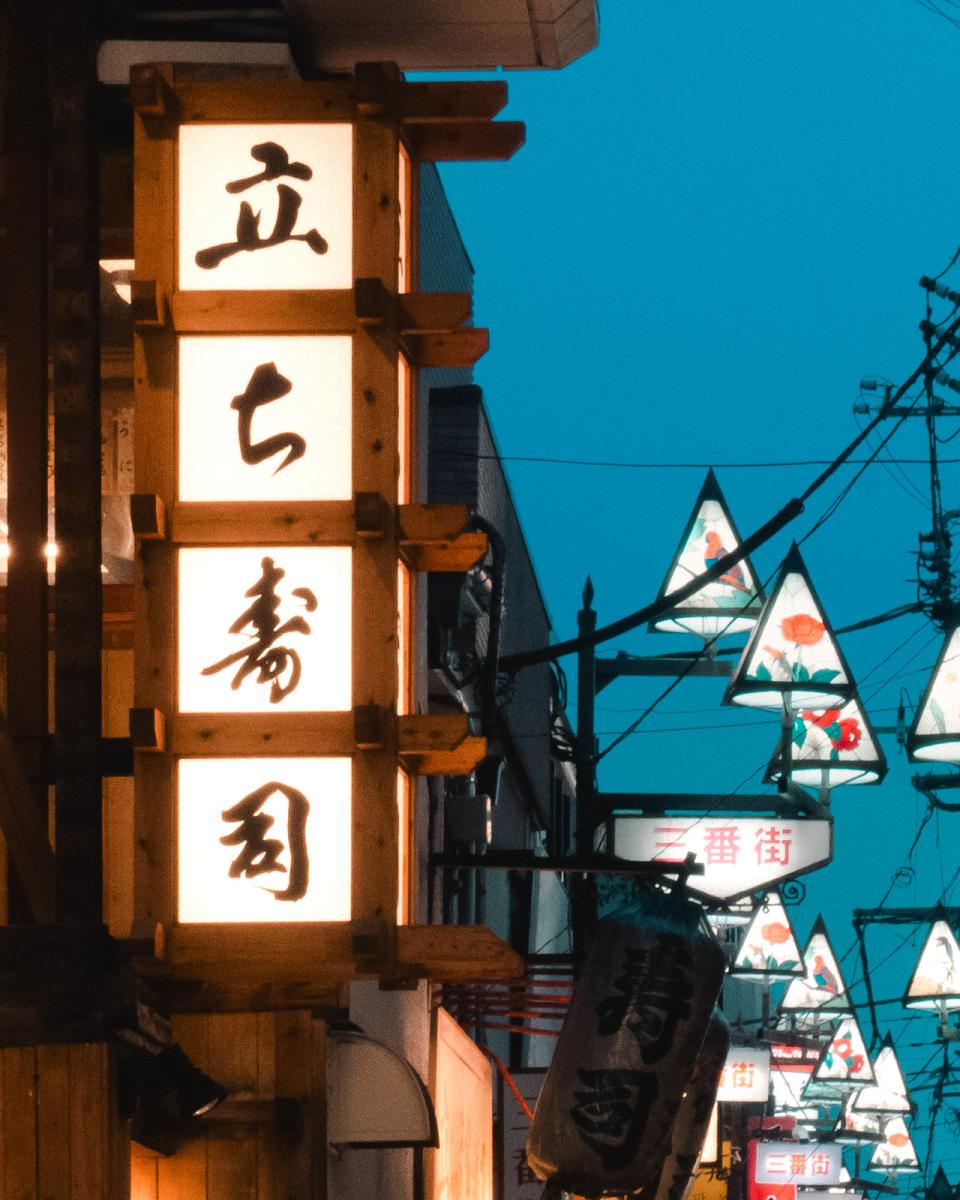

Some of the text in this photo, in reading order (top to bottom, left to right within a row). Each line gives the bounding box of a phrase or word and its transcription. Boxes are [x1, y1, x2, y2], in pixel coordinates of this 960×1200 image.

[194, 140, 329, 903] 立ち寿司
[651, 826, 793, 866] 三番街
[767, 1152, 831, 1176] 三番街
